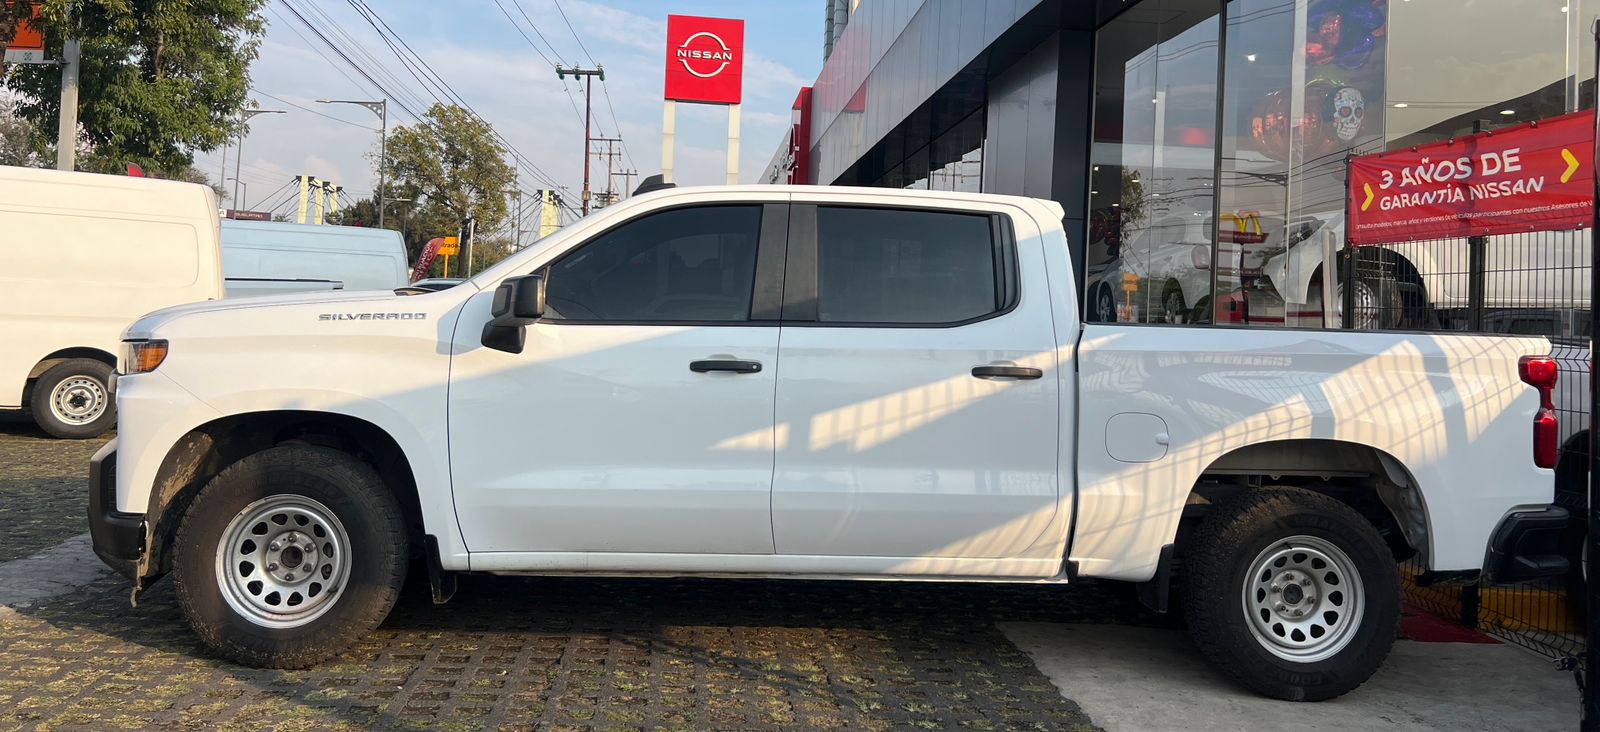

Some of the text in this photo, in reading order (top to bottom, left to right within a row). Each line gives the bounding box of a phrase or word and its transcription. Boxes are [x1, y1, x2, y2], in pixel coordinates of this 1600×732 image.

[677, 49, 732, 60] NISSAN
[1379, 148, 1521, 190] 3 AÑOS DE
[1380, 176, 1544, 211] GARANTÍA NISSAN
[1523, 205, 1550, 214] nuestros
[1551, 202, 1579, 210] Asesores
[1579, 200, 1588, 208] de
[318, 312, 427, 321] SILVERADO
